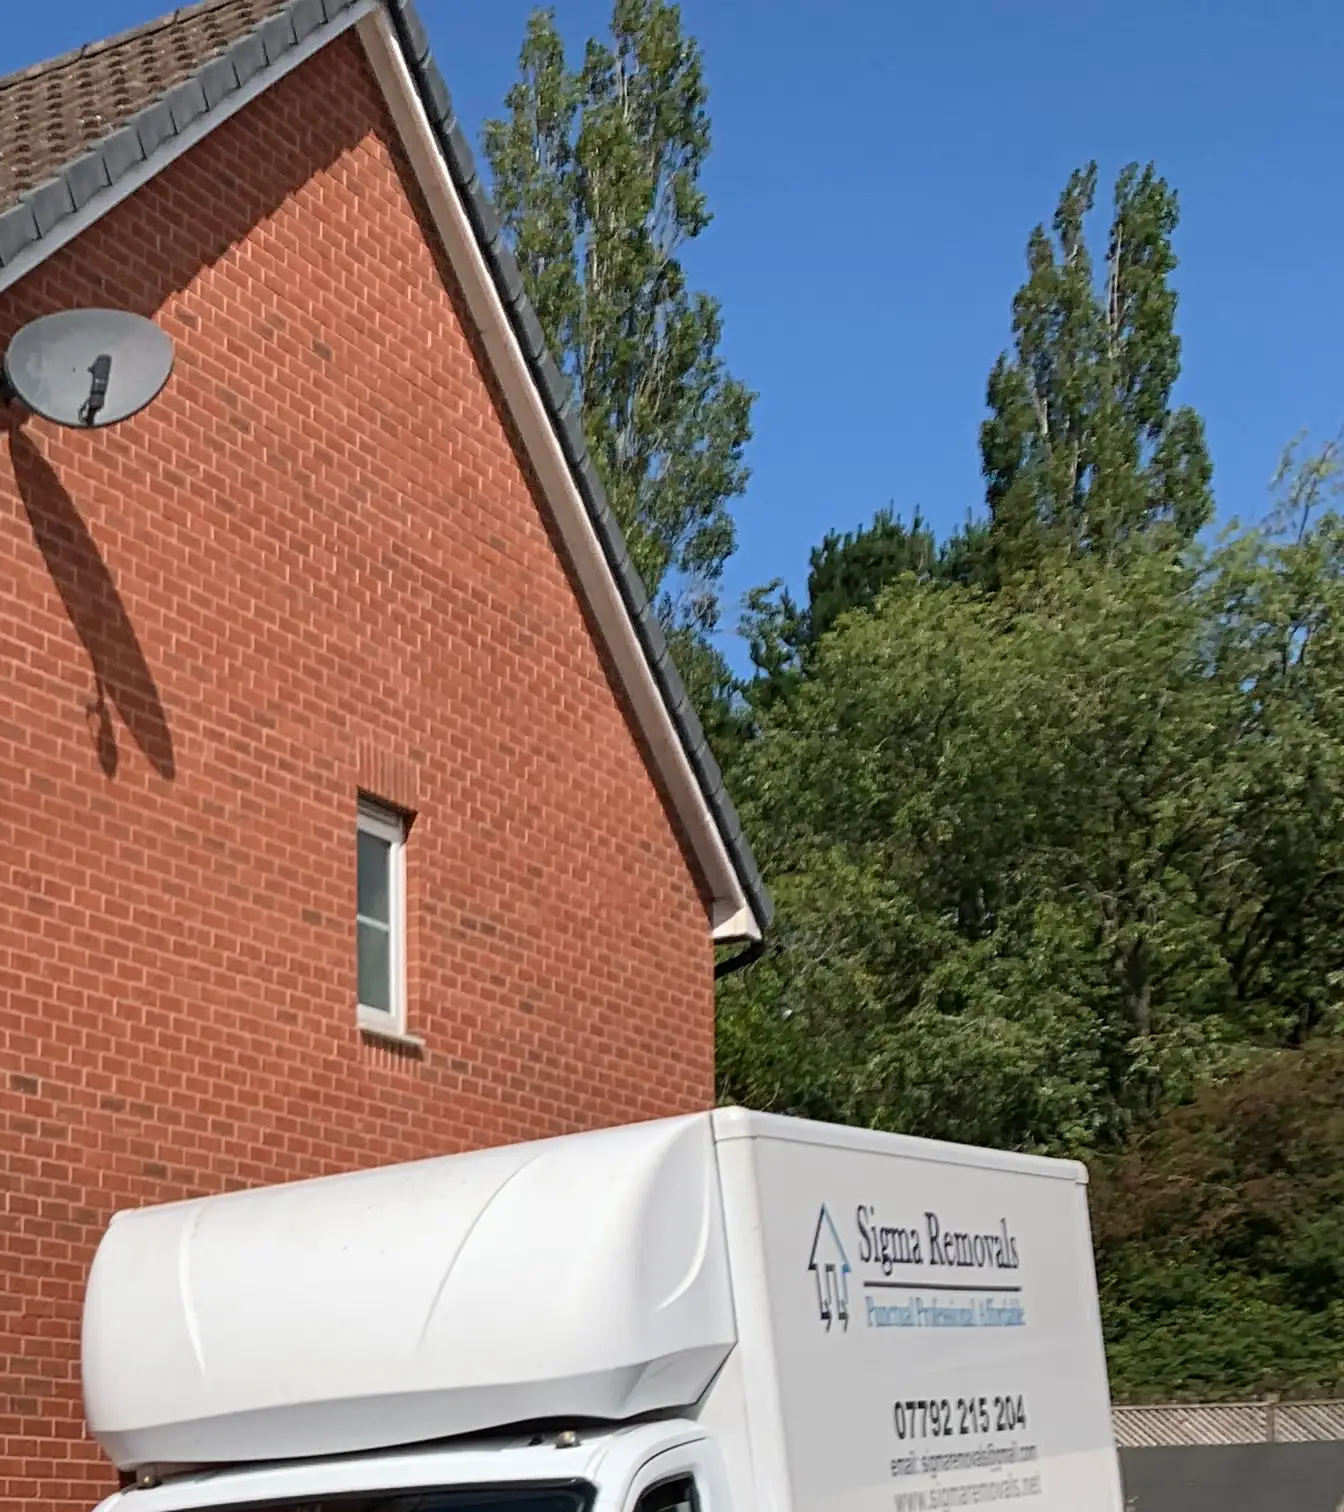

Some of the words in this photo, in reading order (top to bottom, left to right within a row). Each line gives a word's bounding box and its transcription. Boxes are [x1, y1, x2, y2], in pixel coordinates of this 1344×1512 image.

[857, 1205, 924, 1276] Sigma
[924, 1212, 1020, 1269] Removals
[894, 1399, 953, 1439] 07792
[957, 1397, 990, 1435] 215
[994, 1394, 1027, 1431] 204
